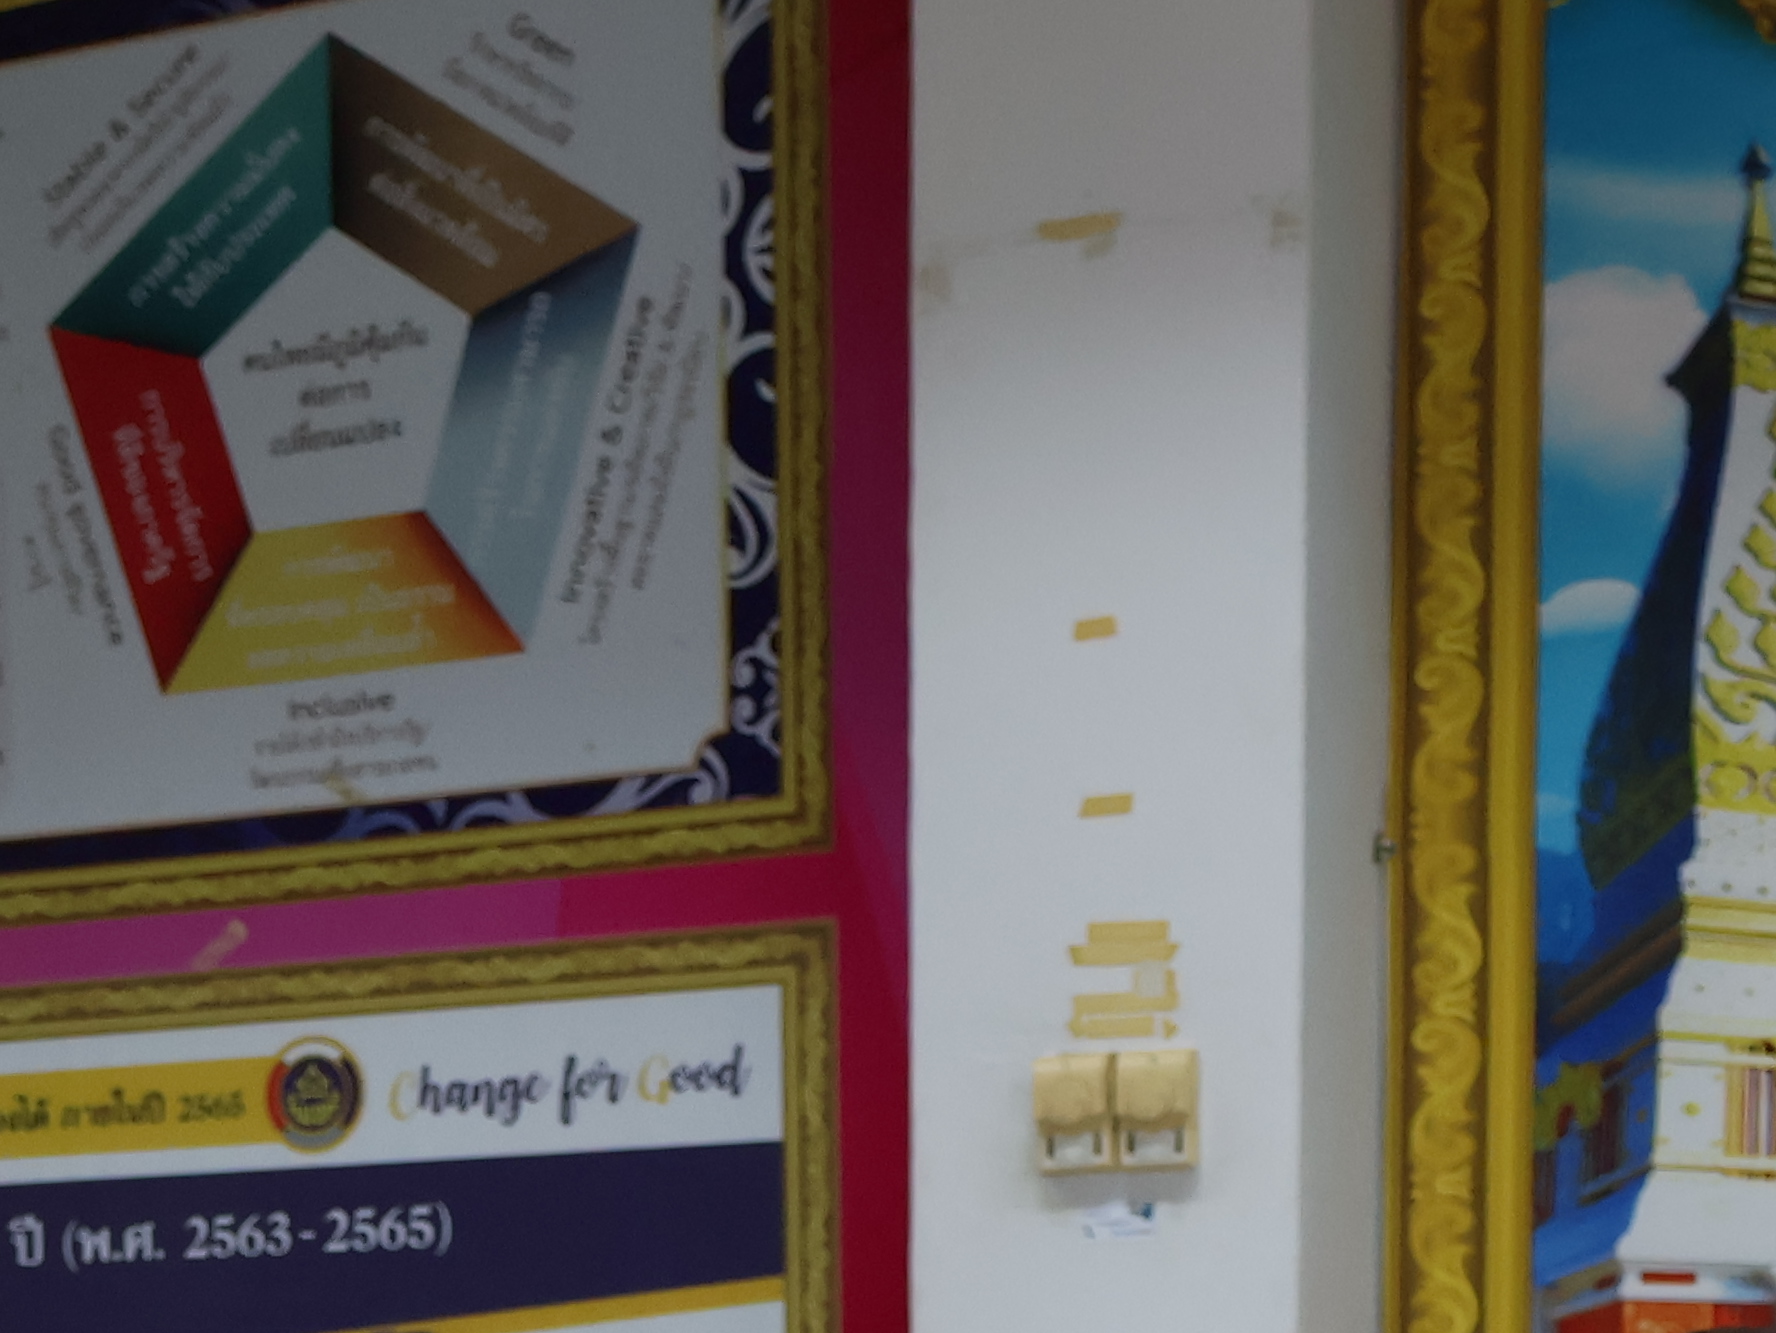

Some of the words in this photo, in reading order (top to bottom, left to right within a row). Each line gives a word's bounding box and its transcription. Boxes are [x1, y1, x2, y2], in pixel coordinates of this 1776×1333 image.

[389, 1064, 544, 1127] Change
[560, 1055, 625, 1126] for
[638, 1044, 748, 1105] Good
[8, 1213, 46, 1269] ปี
